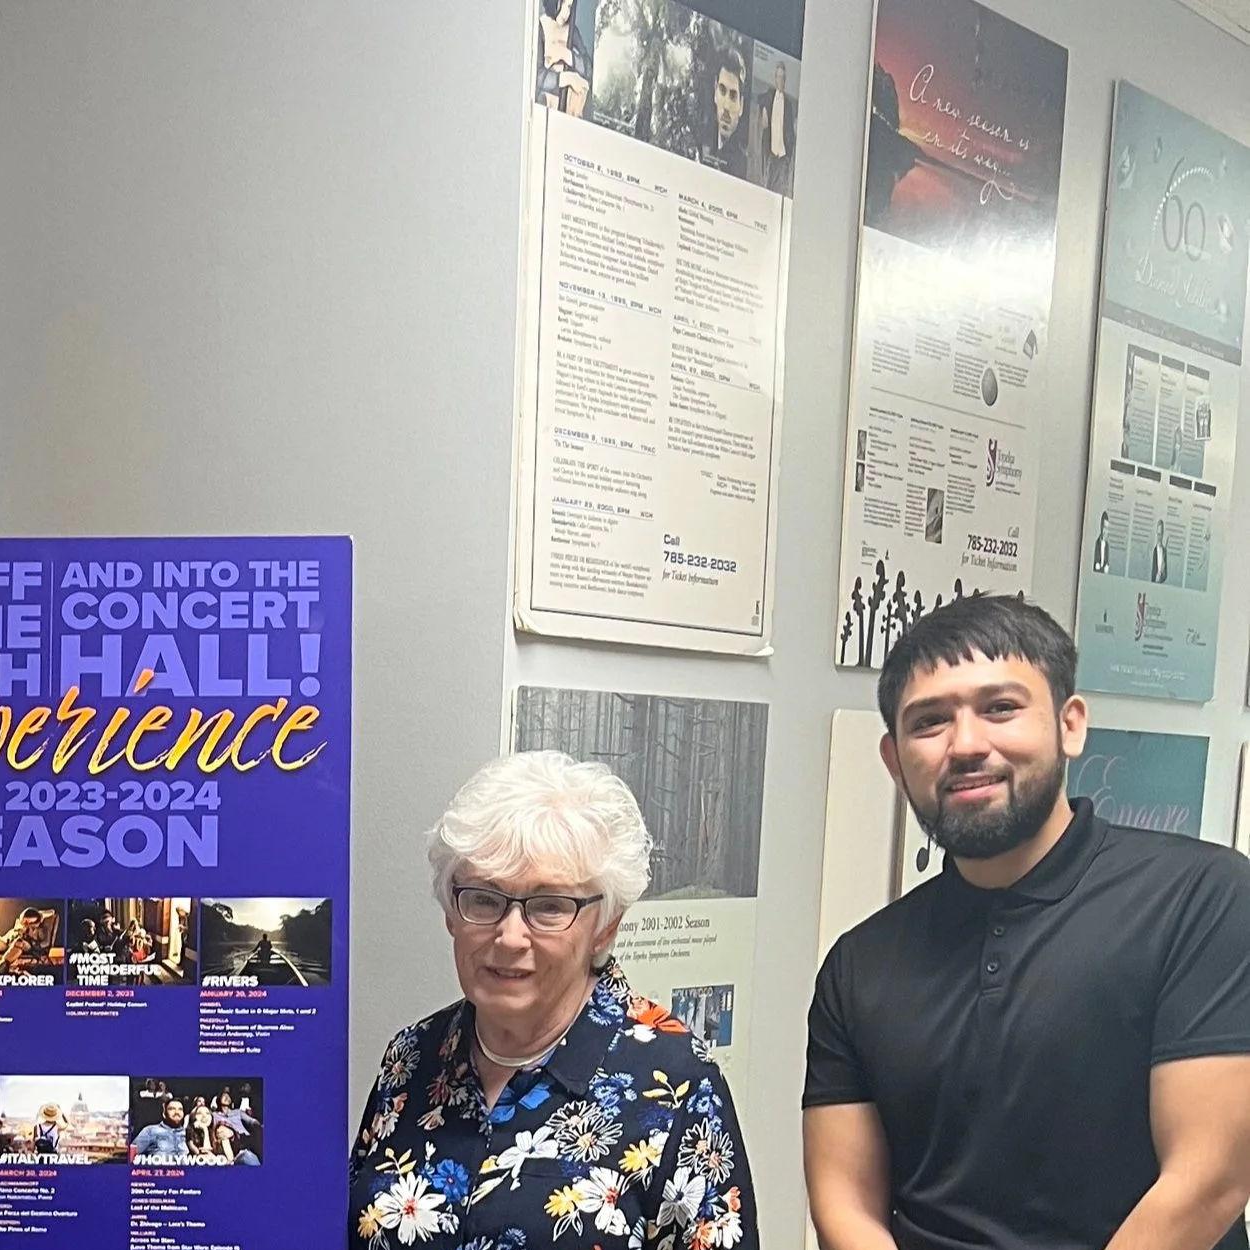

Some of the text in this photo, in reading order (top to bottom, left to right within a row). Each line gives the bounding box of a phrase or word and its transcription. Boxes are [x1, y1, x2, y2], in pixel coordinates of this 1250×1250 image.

[910, 64, 934, 104] A
[932, 98, 962, 119] new
[966, 113, 1012, 143] season
[1007, 526, 1020, 538] Call
[663, 533, 680, 546] Call
[967, 533, 1018, 558] 785-232-2032
[663, 550, 737, 573] 785-232-2032
[961, 552, 1018, 572] for Ticket Information
[61, 561, 320, 588] AND INTO THE
[662, 568, 719, 586] for Ticket Information
[61, 591, 320, 631] CONCERT
[60, 633, 323, 698] HALL!
[5, 780, 222, 812] 2023-2024
[641, 915, 710, 931] 2001-2002 Season
[69, 953, 116, 965] #MOST
[76, 964, 163, 975] WONDERFUL
[76, 975, 109, 986] TIME
[202, 975, 259, 987] #RIVERS
[65, 990, 106, 998] DECEMBER
[199, 990, 234, 998] JANUARY
[0, 1153, 92, 1165] #ITALYTRAVEL
[133, 1154, 228, 1166] #HOLLYWOOD
[131, 1169, 152, 1177] APRIL
